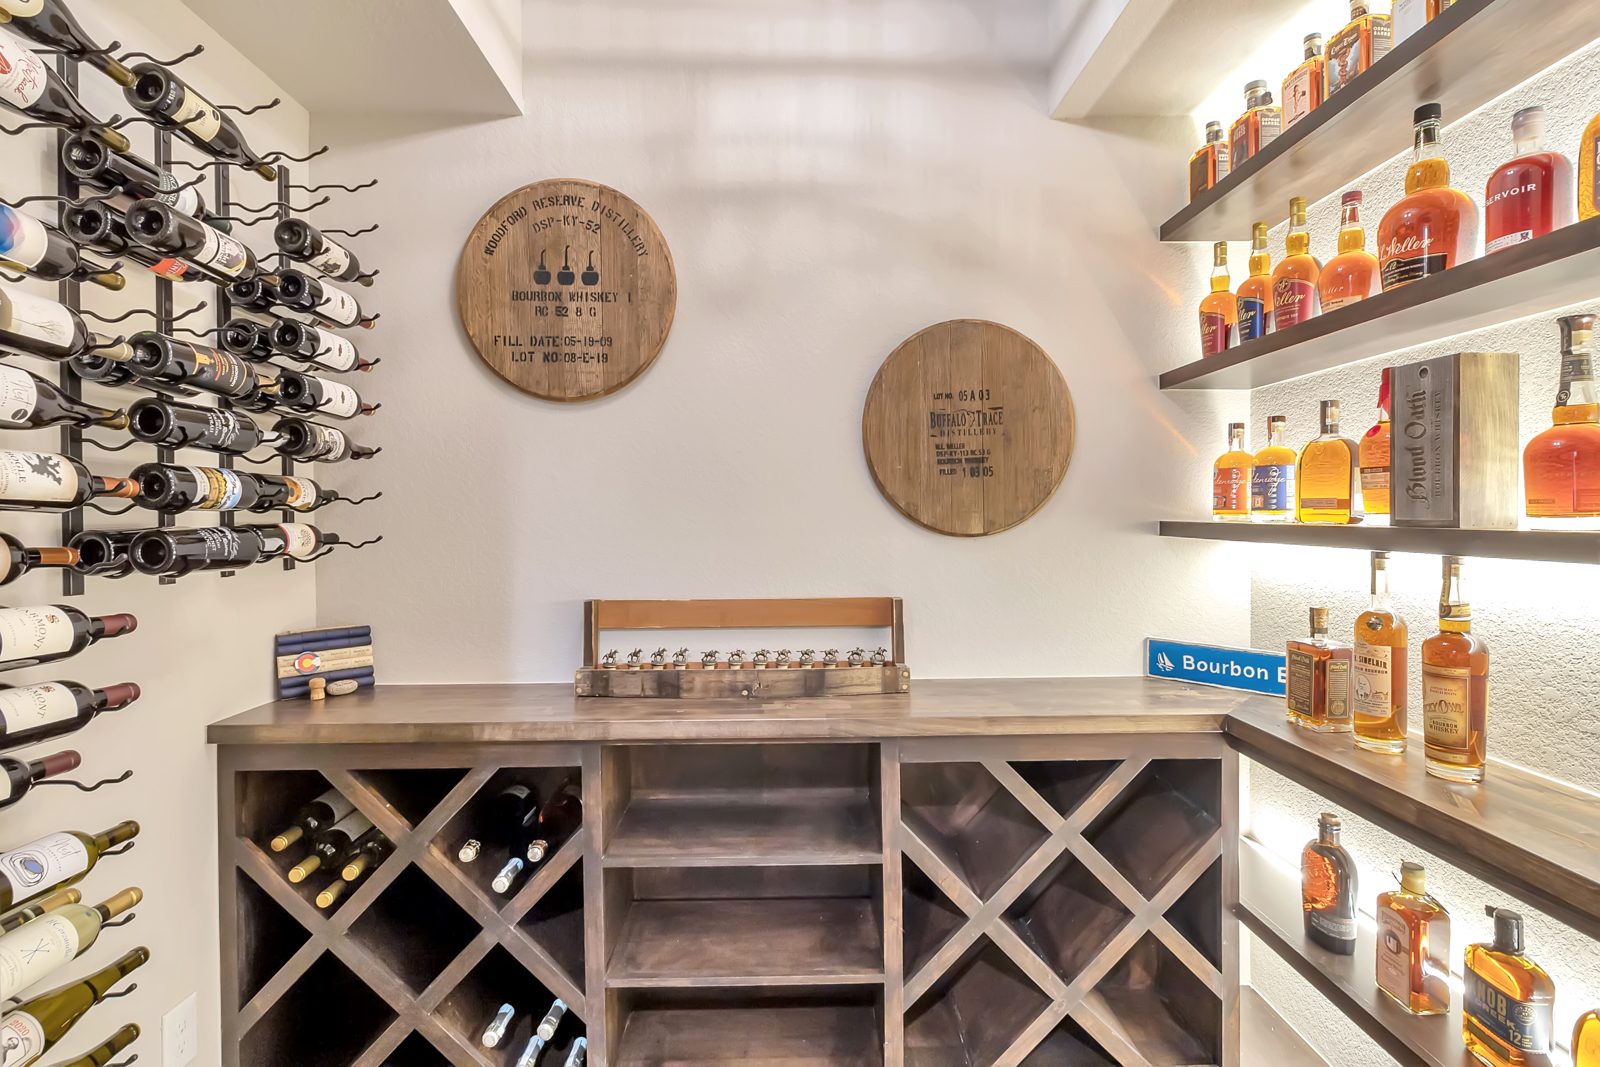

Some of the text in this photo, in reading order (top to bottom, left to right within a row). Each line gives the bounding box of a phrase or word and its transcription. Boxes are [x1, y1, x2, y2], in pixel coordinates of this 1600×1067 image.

[484, 195, 649, 258] WOODFORD RESERVE DISTILLERY
[532, 215, 601, 235] DSP-KY-52
[512, 290, 562, 302] BOURBON
[569, 291, 618, 303] WHISKEY
[535, 306, 548, 317] RC
[555, 306, 569, 318] 52
[575, 306, 582, 317] 8
[494, 335, 523, 348] FILL
[511, 351, 535, 363] LOT
[958, 390, 968, 402] 05
[970, 390, 976, 401] A
[930, 409, 1004, 430] BUFFALO TRACE
[940, 427, 997, 438] DISTILLERY
[983, 466, 994, 478] 05
[1182, 655, 1269, 681] Bourbon
[1429, 725, 1459, 735] WHISKEY
[1432, 720, 1458, 729] BOURBON
[1508, 1029, 1522, 1045] 12
